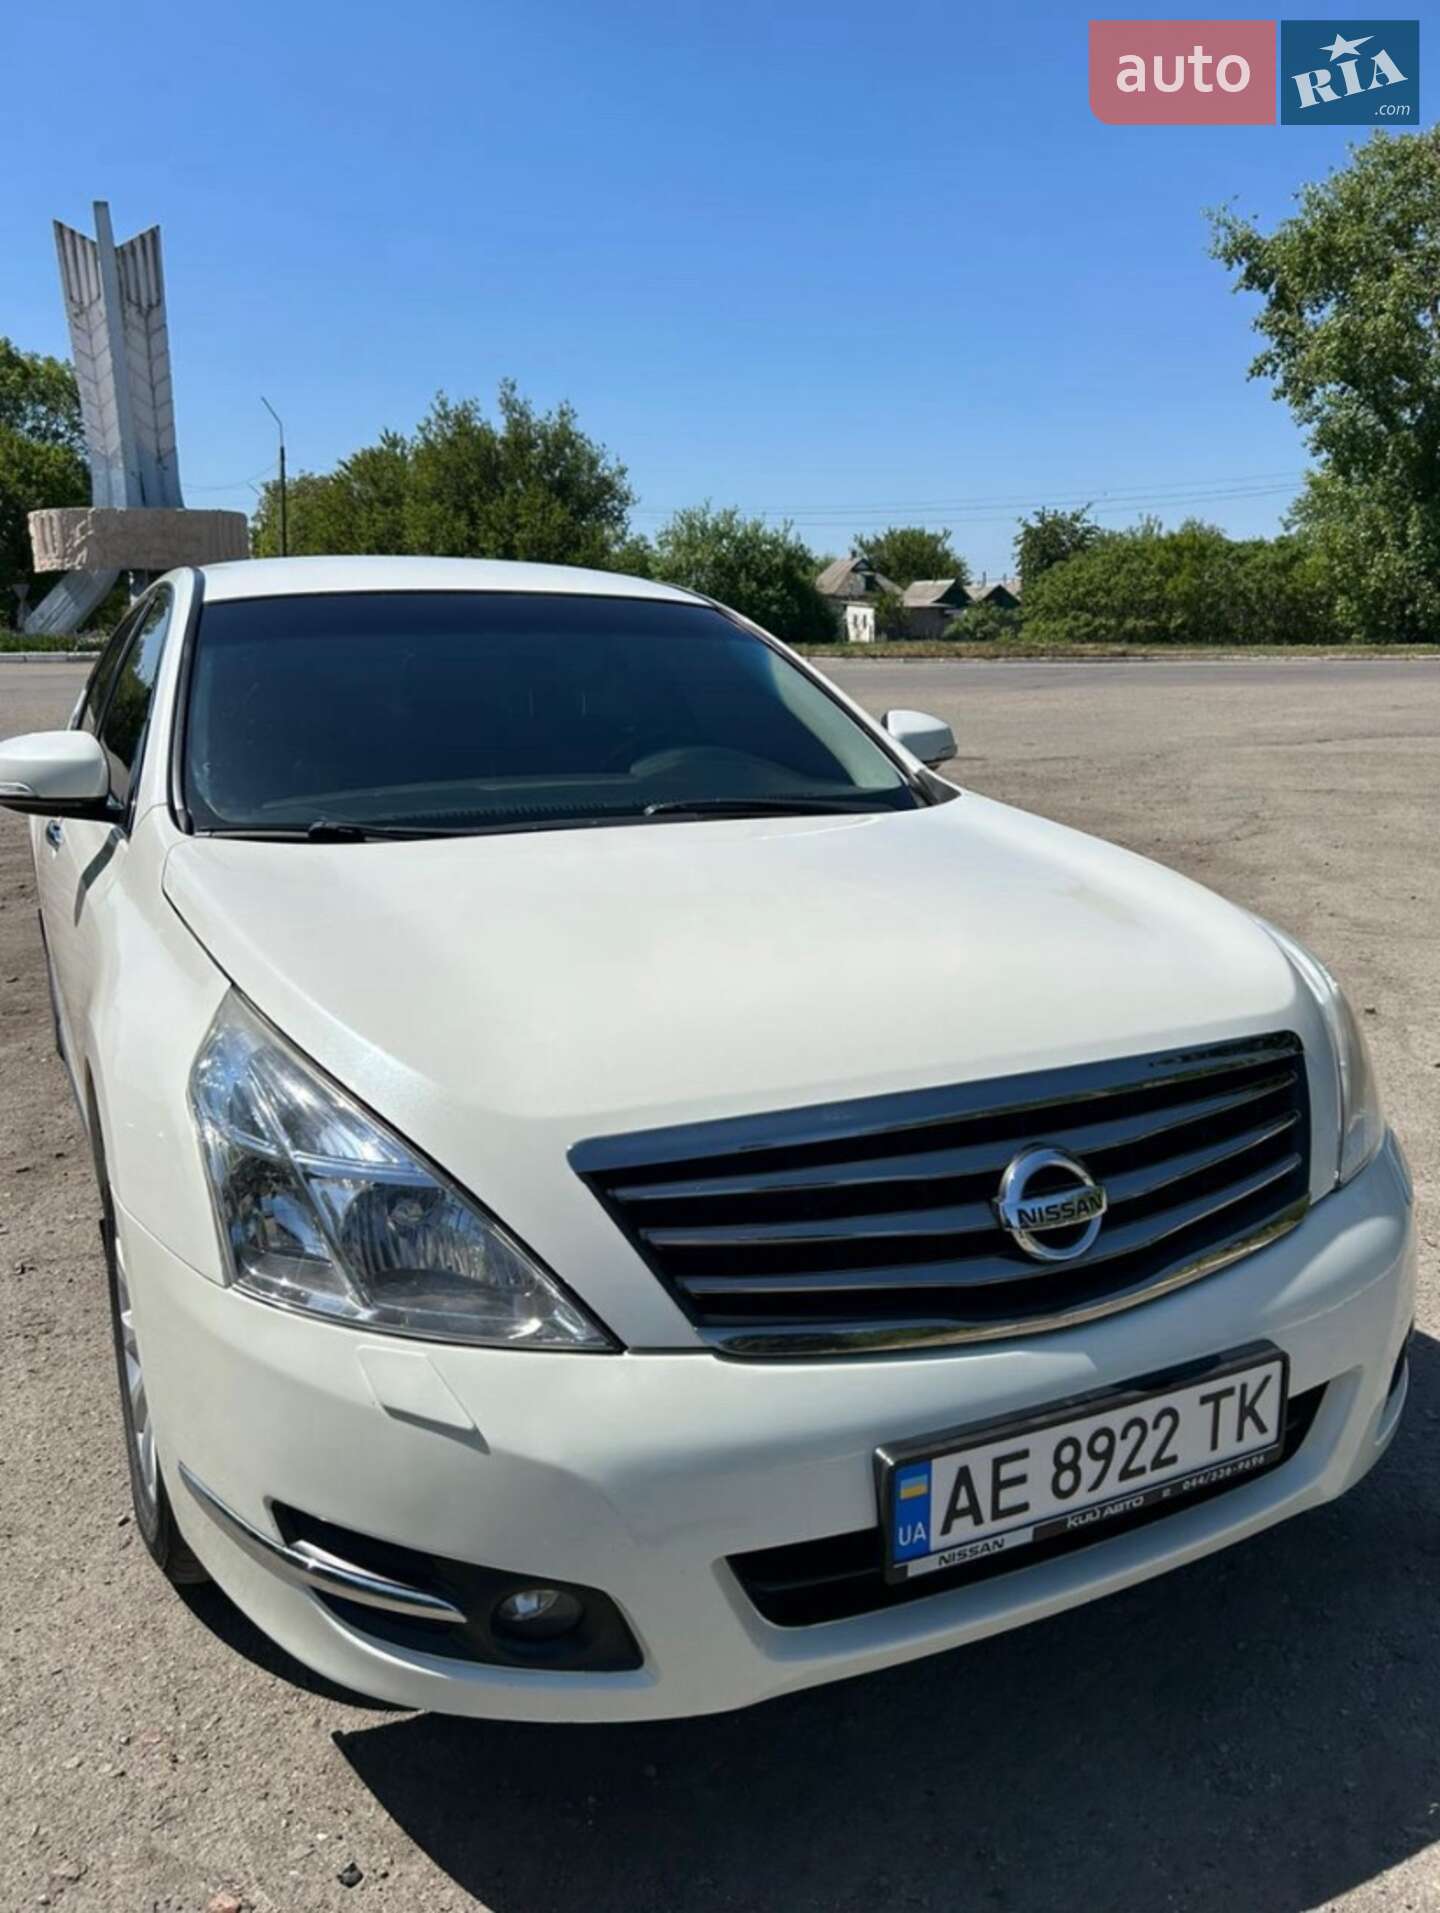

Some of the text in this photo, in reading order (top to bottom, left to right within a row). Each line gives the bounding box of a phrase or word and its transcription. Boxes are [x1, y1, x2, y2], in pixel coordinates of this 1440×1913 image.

[1017, 1191, 1103, 1226] NISSAN
[940, 1374, 1273, 1536] AE 8922 TK
[899, 1521, 927, 1546] UA
[938, 1538, 1005, 1566] NISSAN
